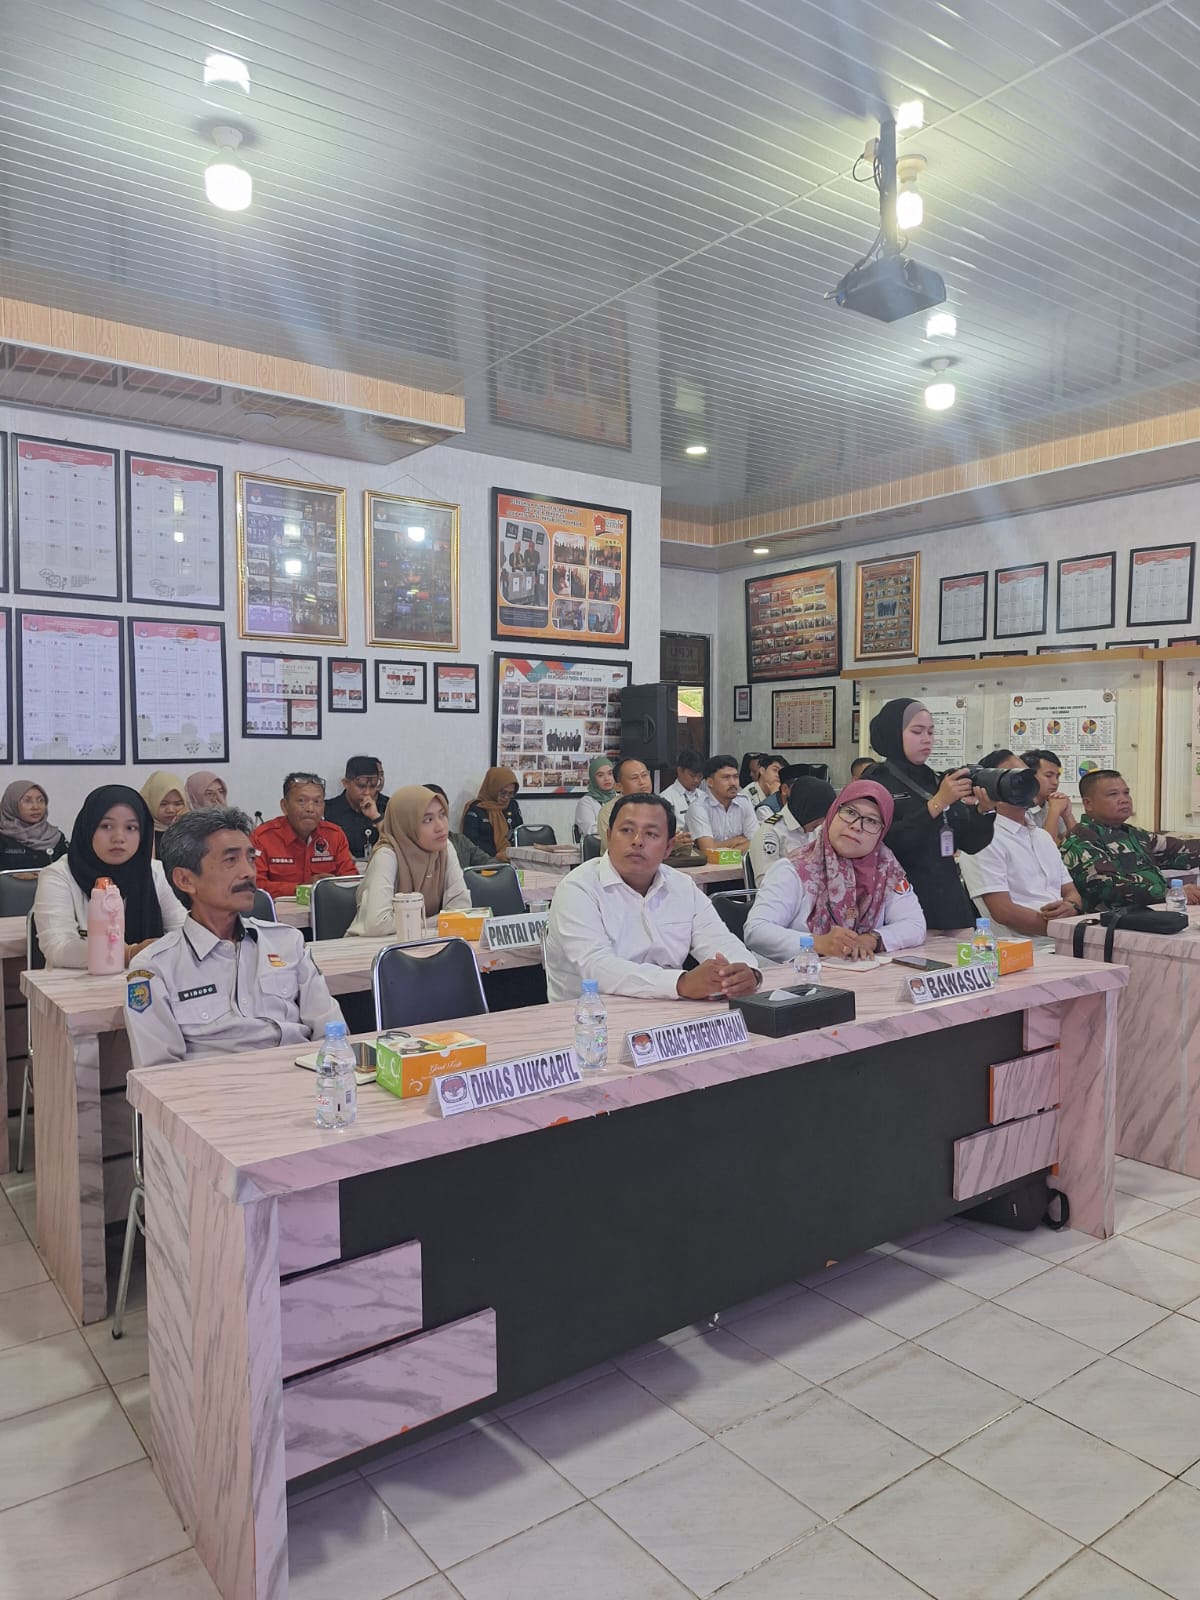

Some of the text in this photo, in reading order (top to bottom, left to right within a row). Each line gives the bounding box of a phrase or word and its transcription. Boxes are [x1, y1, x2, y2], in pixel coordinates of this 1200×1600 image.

[488, 922, 529, 947] PARTAI
[926, 966, 991, 998] BAWASLU
[655, 1015, 747, 1059] KABAG PEMERINTAHAN
[470, 1052, 580, 1105] DINAS DUKCAPIL
